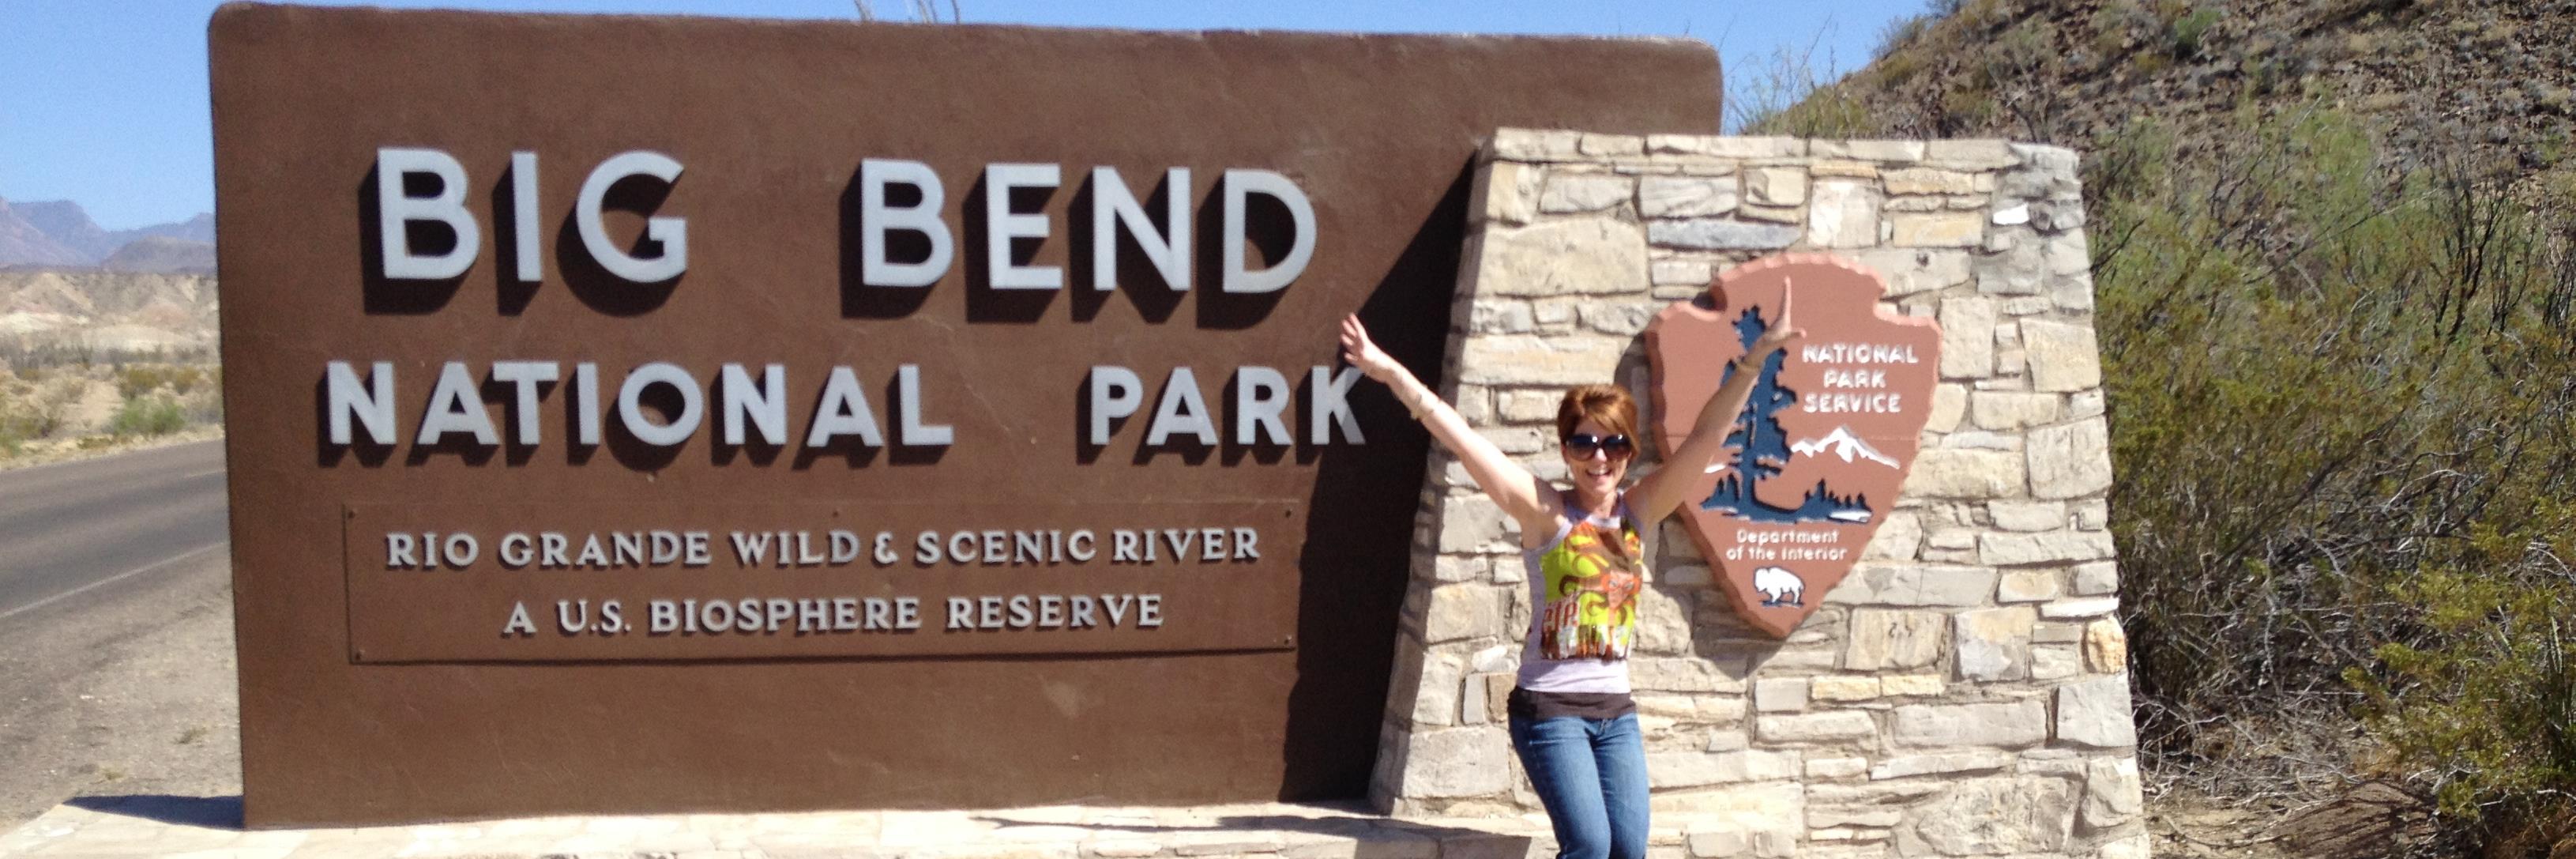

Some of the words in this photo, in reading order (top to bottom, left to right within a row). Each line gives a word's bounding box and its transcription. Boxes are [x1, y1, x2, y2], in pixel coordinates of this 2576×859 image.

[378, 148, 687, 283] BIG
[861, 158, 1318, 293] BEND
[1802, 342, 1919, 364] NATIONAL
[1823, 368, 1887, 389] PARK
[326, 360, 954, 447] NATIONAL
[1091, 364, 1367, 446] PARK
[1803, 393, 1902, 413] SERVICE
[386, 531, 479, 567] RIO
[500, 529, 712, 567] GRANDE
[731, 529, 860, 567] WILD
[874, 531, 899, 564] &
[916, 529, 1097, 564] SCENIC
[1112, 527, 1261, 562] RIVER
[1736, 528, 1840, 545] Department
[1725, 544, 1745, 561] of
[1748, 545, 1777, 561] the
[1781, 545, 1848, 561] Interior
[503, 601, 537, 634] A
[558, 599, 632, 633] U.S.
[649, 597, 923, 632] BIOSPHERE
[948, 593, 1164, 629] RESERVE
